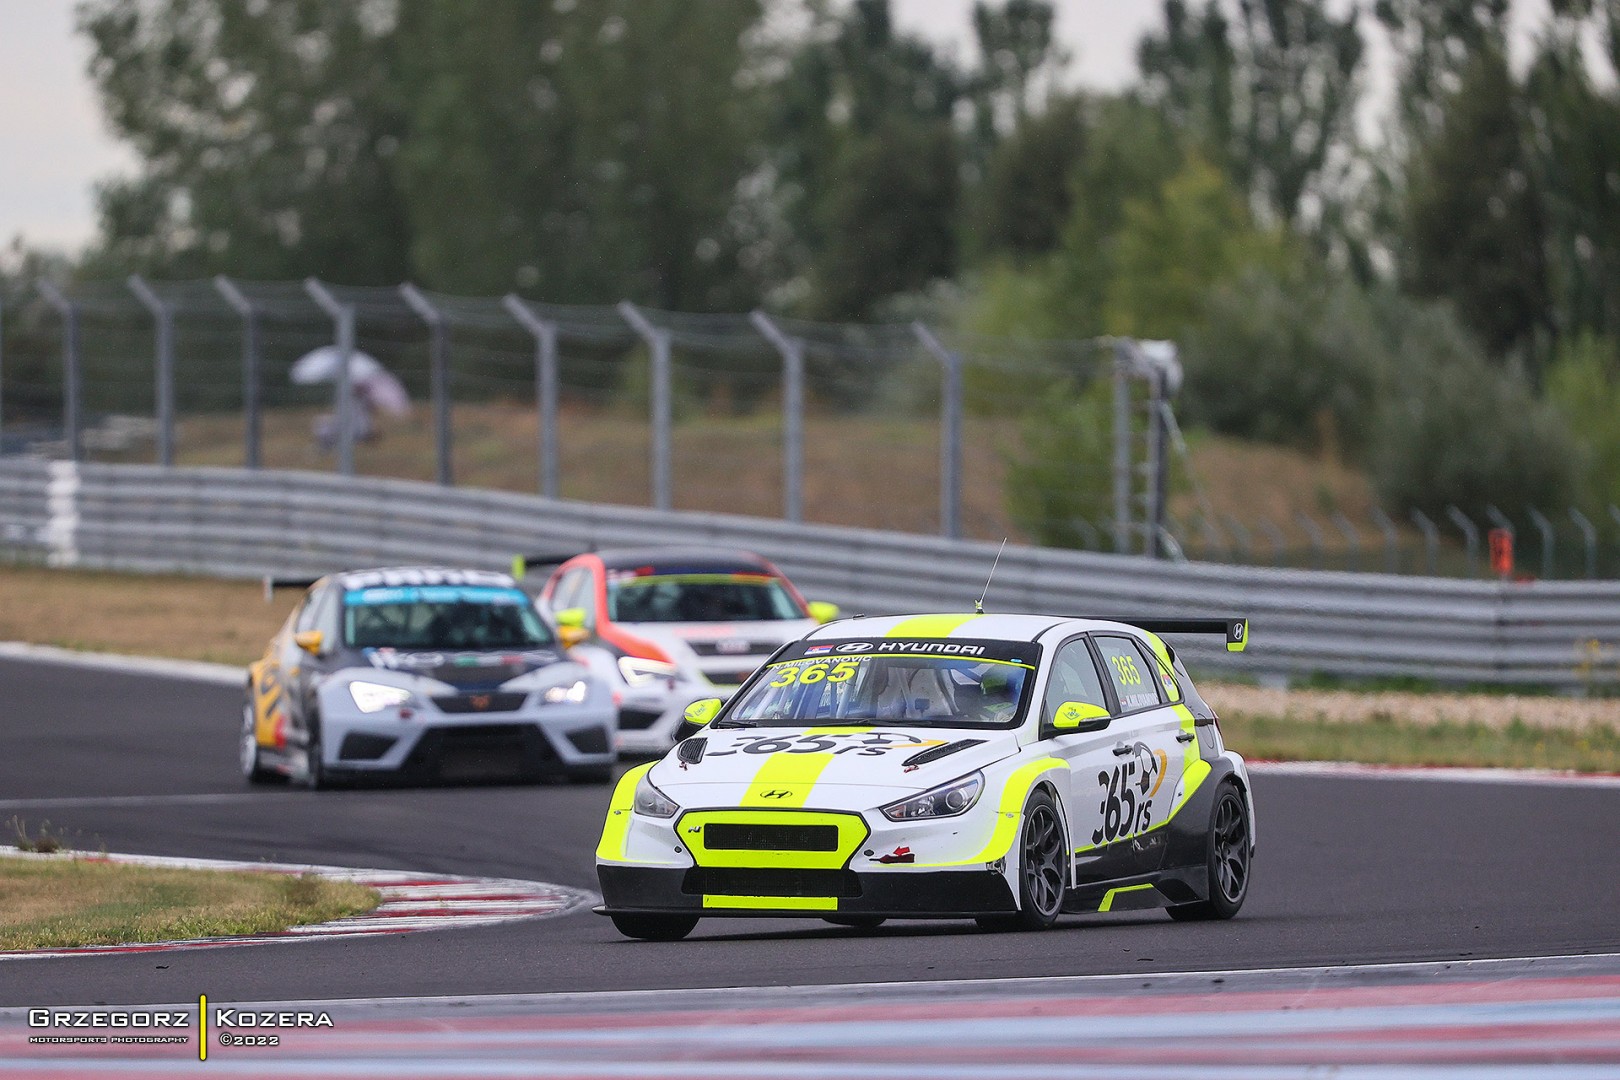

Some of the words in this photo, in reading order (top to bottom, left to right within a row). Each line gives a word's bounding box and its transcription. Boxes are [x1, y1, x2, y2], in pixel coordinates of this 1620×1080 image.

[877, 642, 986, 656] HYUNDAI
[769, 661, 860, 688] 365
[1111, 655, 1141, 686] 365
